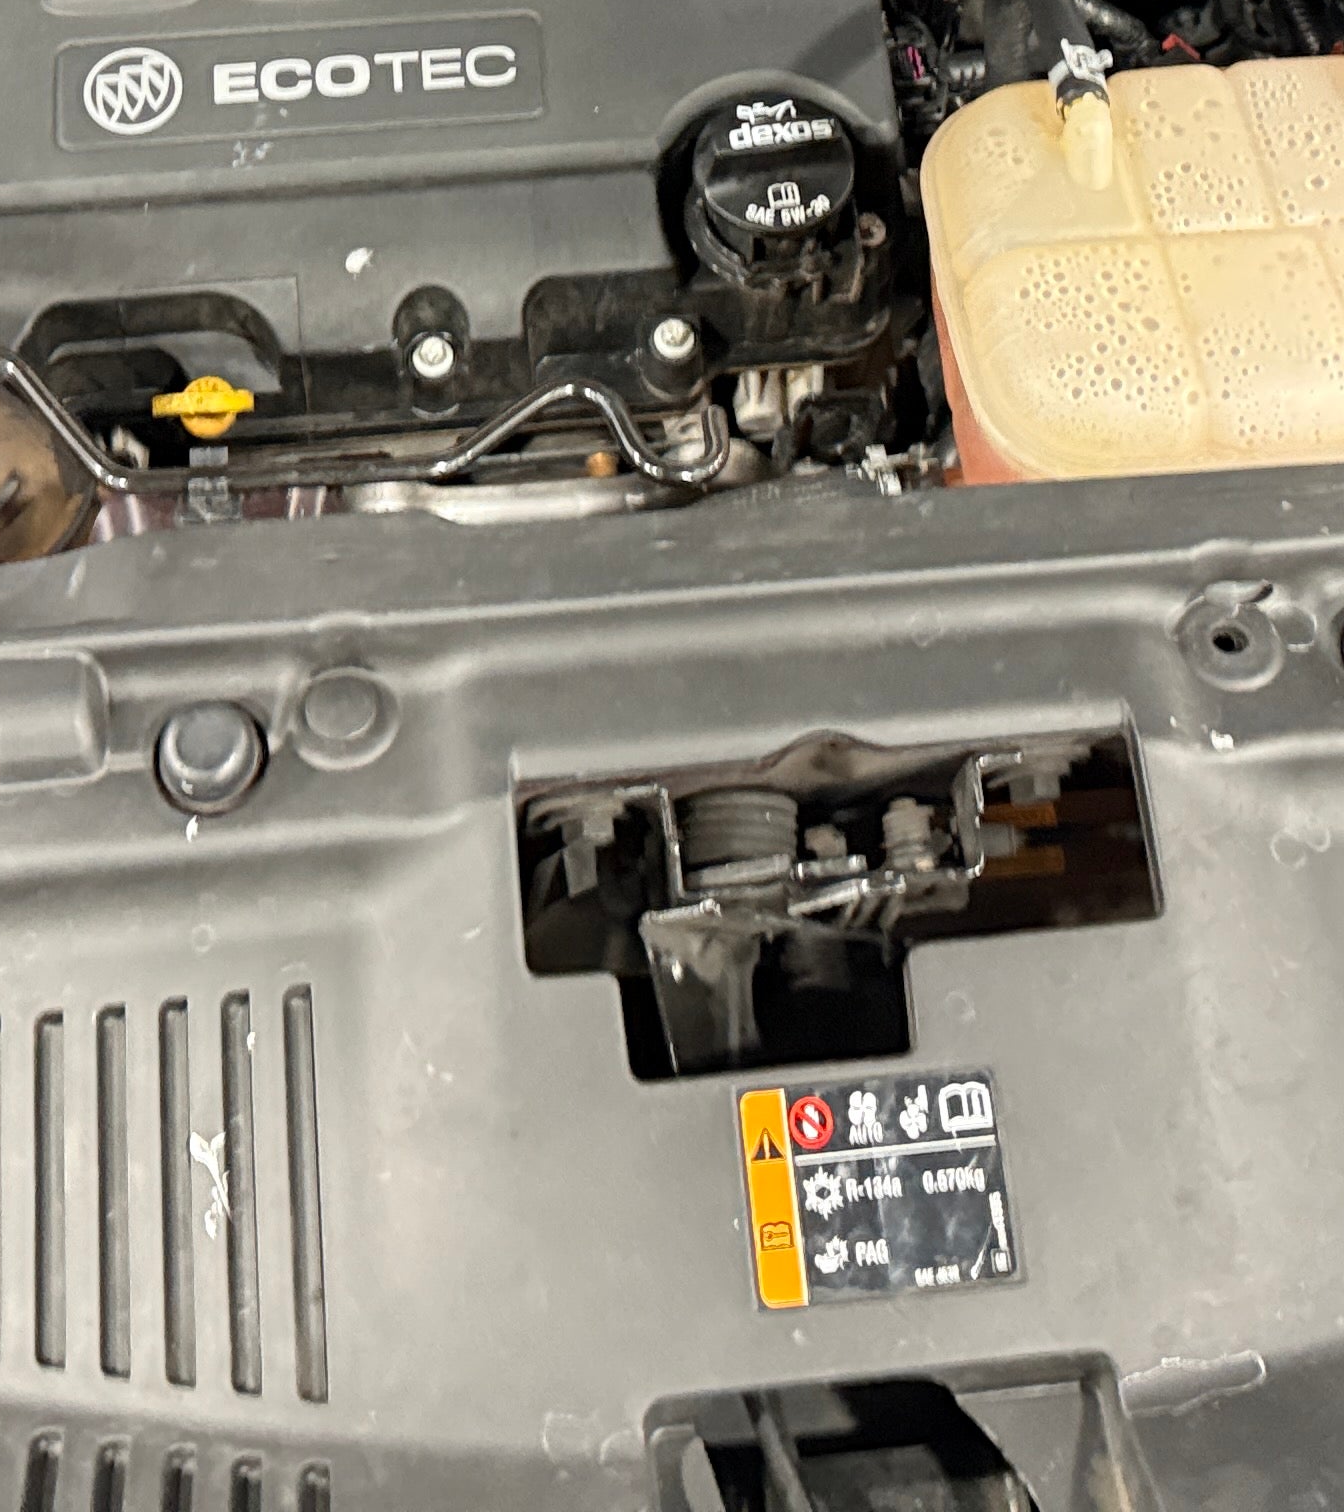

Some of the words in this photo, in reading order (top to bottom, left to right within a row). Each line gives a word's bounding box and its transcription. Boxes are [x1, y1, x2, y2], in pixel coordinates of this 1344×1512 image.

[213, 44, 517, 105] ECOTEC
[729, 119, 833, 150] dexos
[848, 1121, 884, 1146] AUTO
[846, 1174, 903, 1202] R-134a
[855, 1238, 890, 1267] PAG
